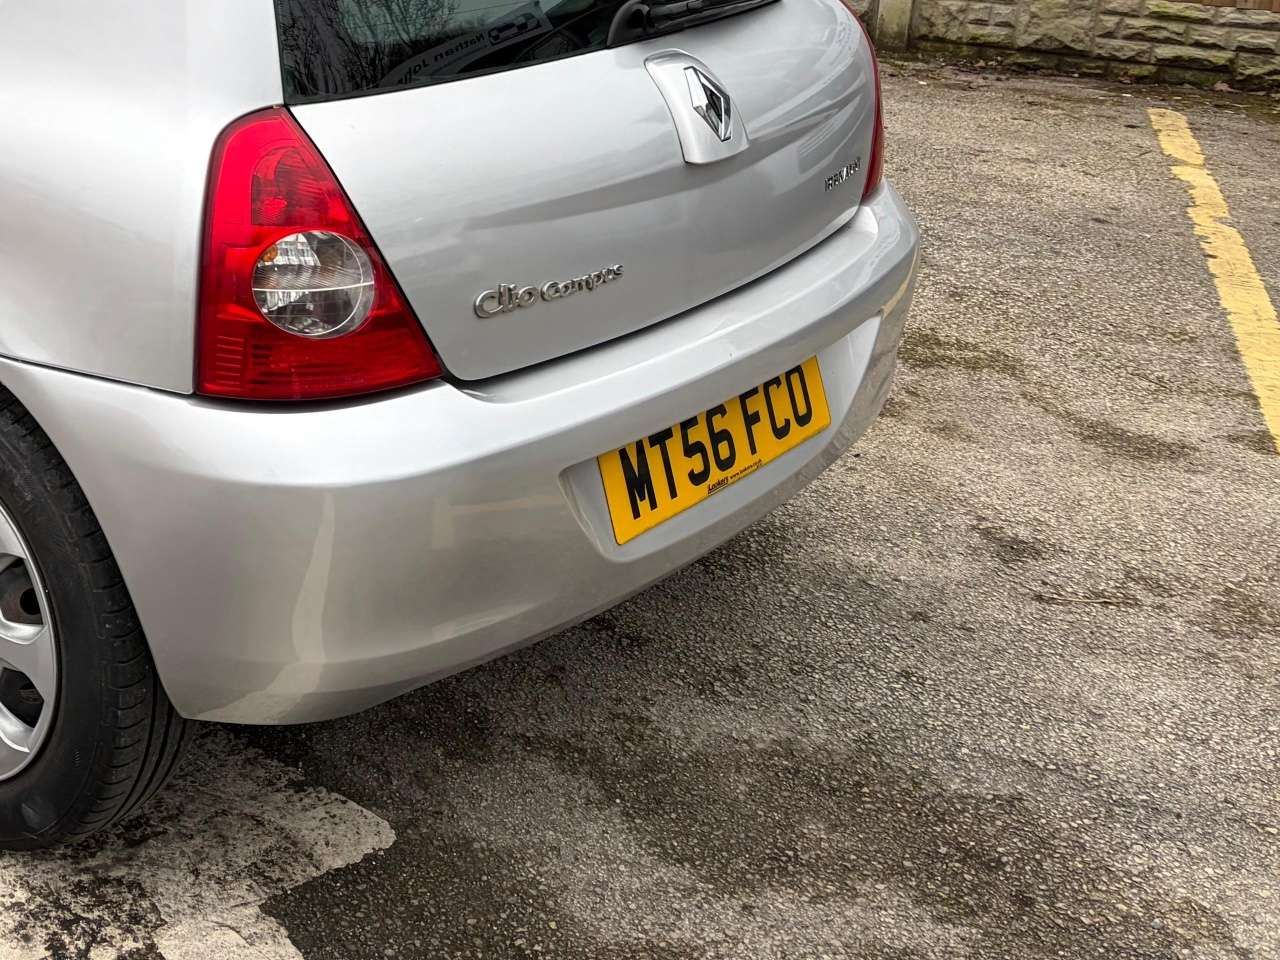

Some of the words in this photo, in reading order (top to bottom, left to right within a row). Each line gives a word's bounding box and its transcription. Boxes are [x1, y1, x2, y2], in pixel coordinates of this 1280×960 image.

[473, 283, 540, 319] Clio
[540, 264, 624, 302] Campus
[618, 403, 737, 521] MT56
